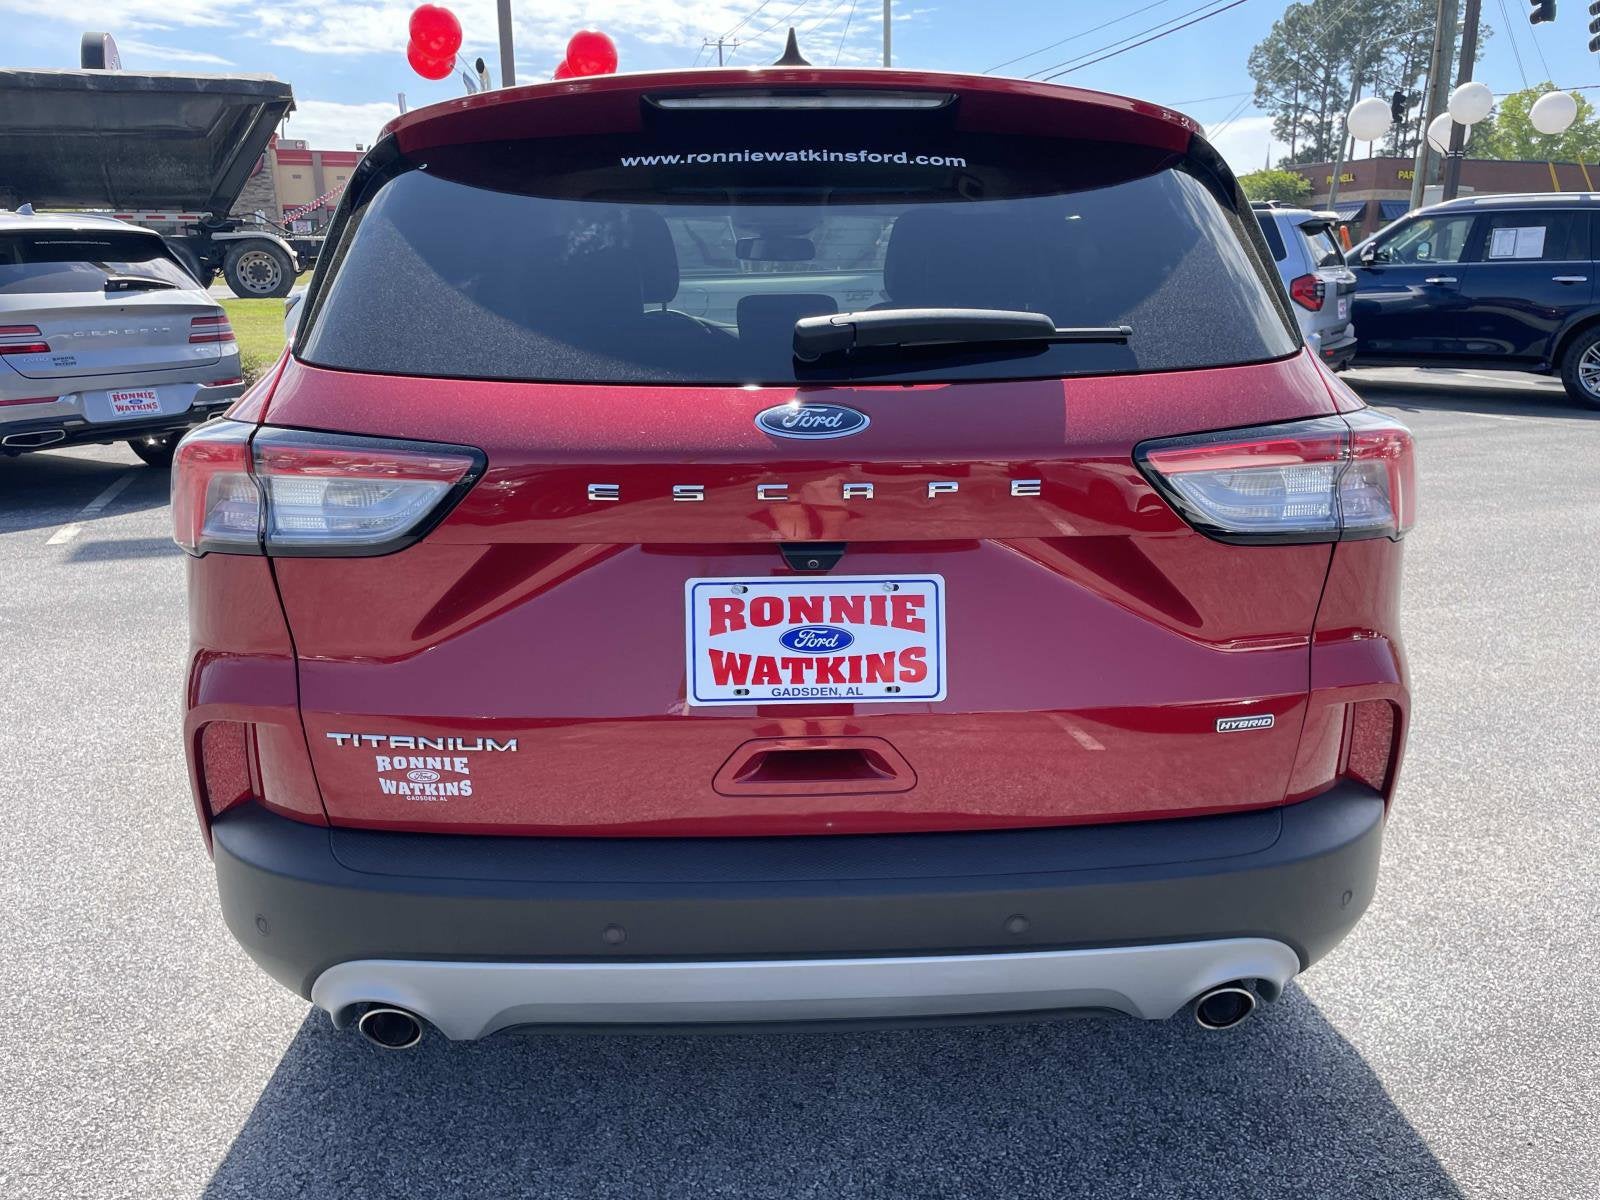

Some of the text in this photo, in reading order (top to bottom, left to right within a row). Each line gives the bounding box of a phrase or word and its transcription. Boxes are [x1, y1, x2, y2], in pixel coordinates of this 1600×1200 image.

[620, 149, 967, 168] www.ronniewatkinsford.com
[1326, 173, 1355, 185] PANELL
[1397, 169, 1416, 180] PAR
[112, 391, 156, 402] RONNIE
[115, 402, 158, 412] WATKINS
[782, 407, 843, 428] Ford
[587, 479, 1042, 502] ESCAPE
[708, 595, 926, 637] RONNIE
[794, 631, 839, 648] Ford
[708, 646, 928, 686] WATKINS
[771, 686, 864, 698] GADSDEN, AL
[1220, 718, 1272, 730] HYBRID
[326, 732, 519, 752] TITANIUM
[375, 756, 470, 774] RONNIE
[378, 778, 473, 796] WATKINS
